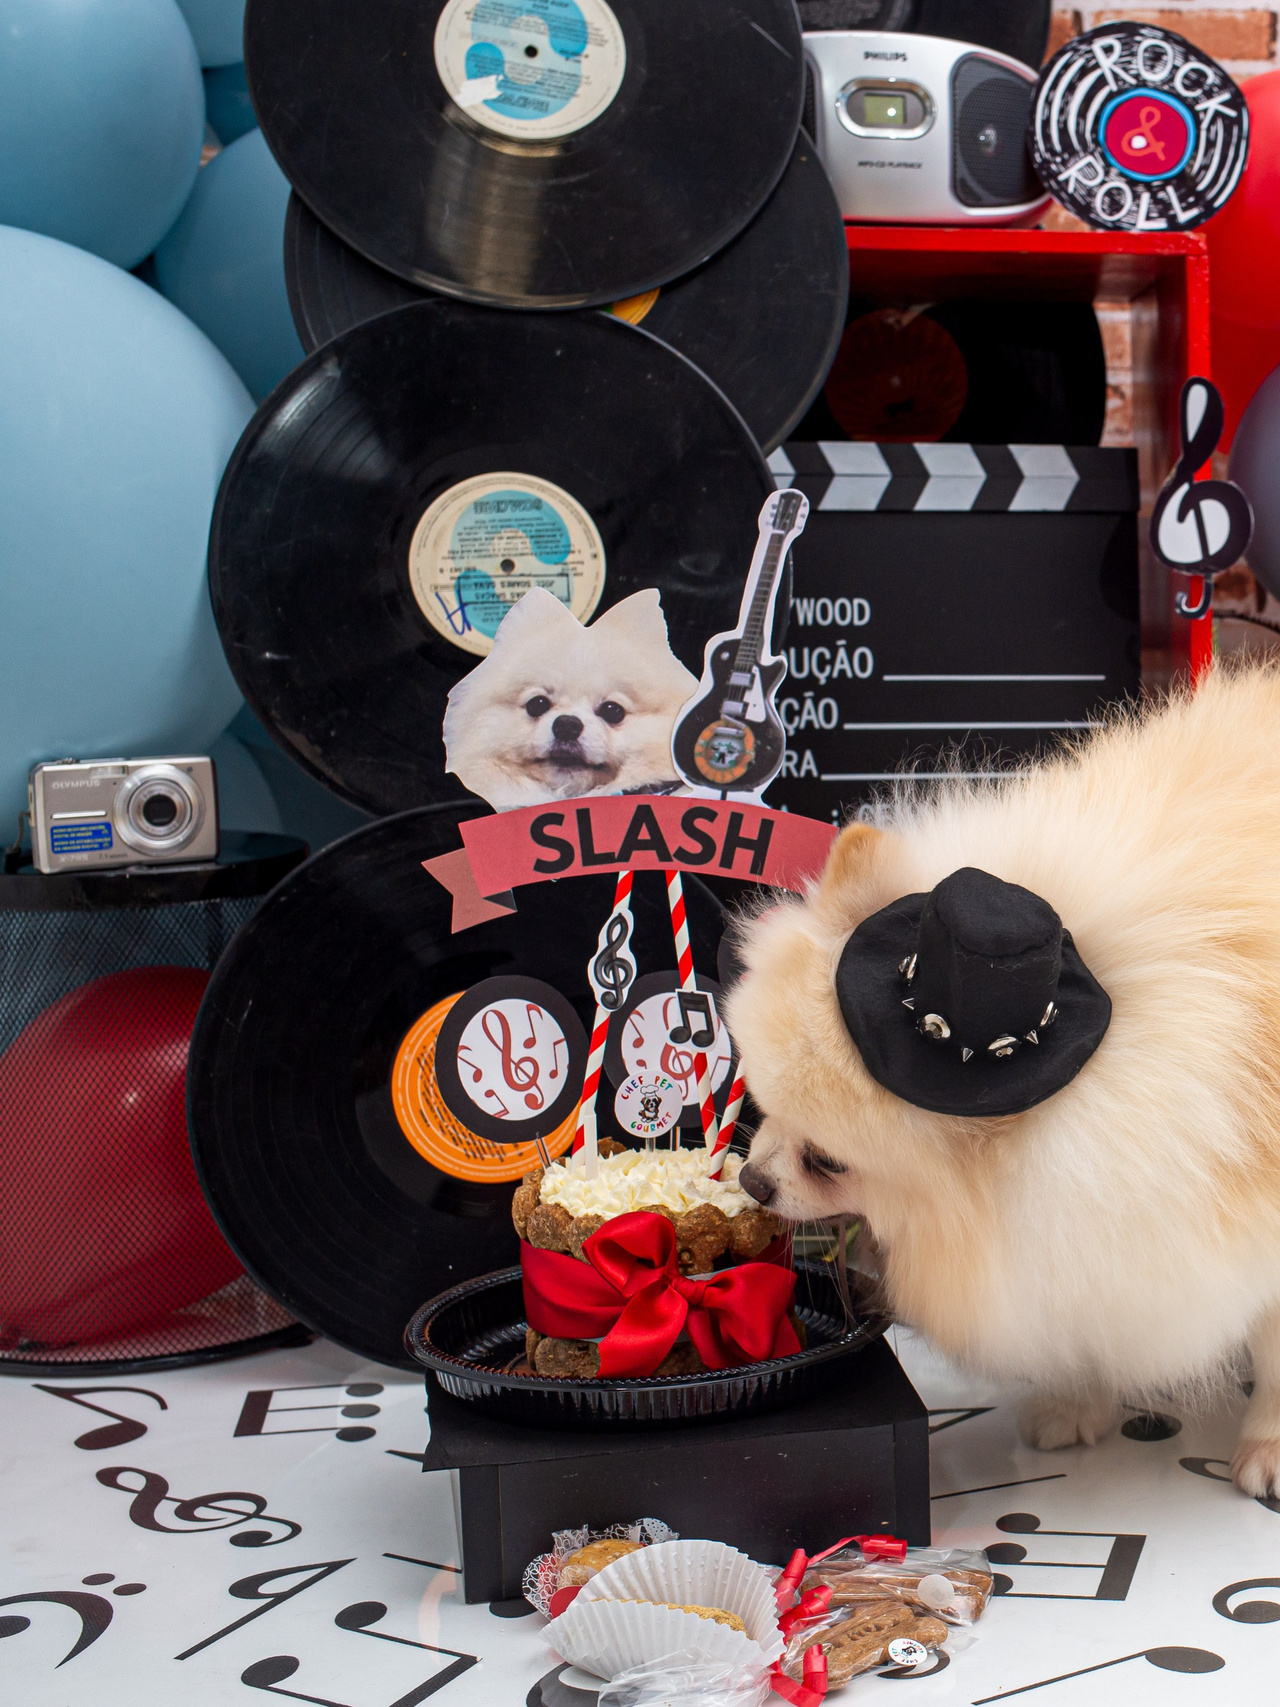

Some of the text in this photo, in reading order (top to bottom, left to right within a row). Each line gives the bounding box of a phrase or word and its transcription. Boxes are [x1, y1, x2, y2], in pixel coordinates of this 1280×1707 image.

[863, 51, 908, 62] PHILIPS
[1092, 38, 1238, 131] ROCK
[1057, 155, 1201, 230] ROLL
[781, 639, 874, 685] UÇÃO
[775, 691, 839, 736] ÇÃO
[777, 749, 819, 778] RA
[52, 780, 101, 790] OLYMPUS
[530, 804, 774, 876] SLASH
[621, 1075, 673, 1100] CHEF PET
[630, 1111, 672, 1132] GOURMET
